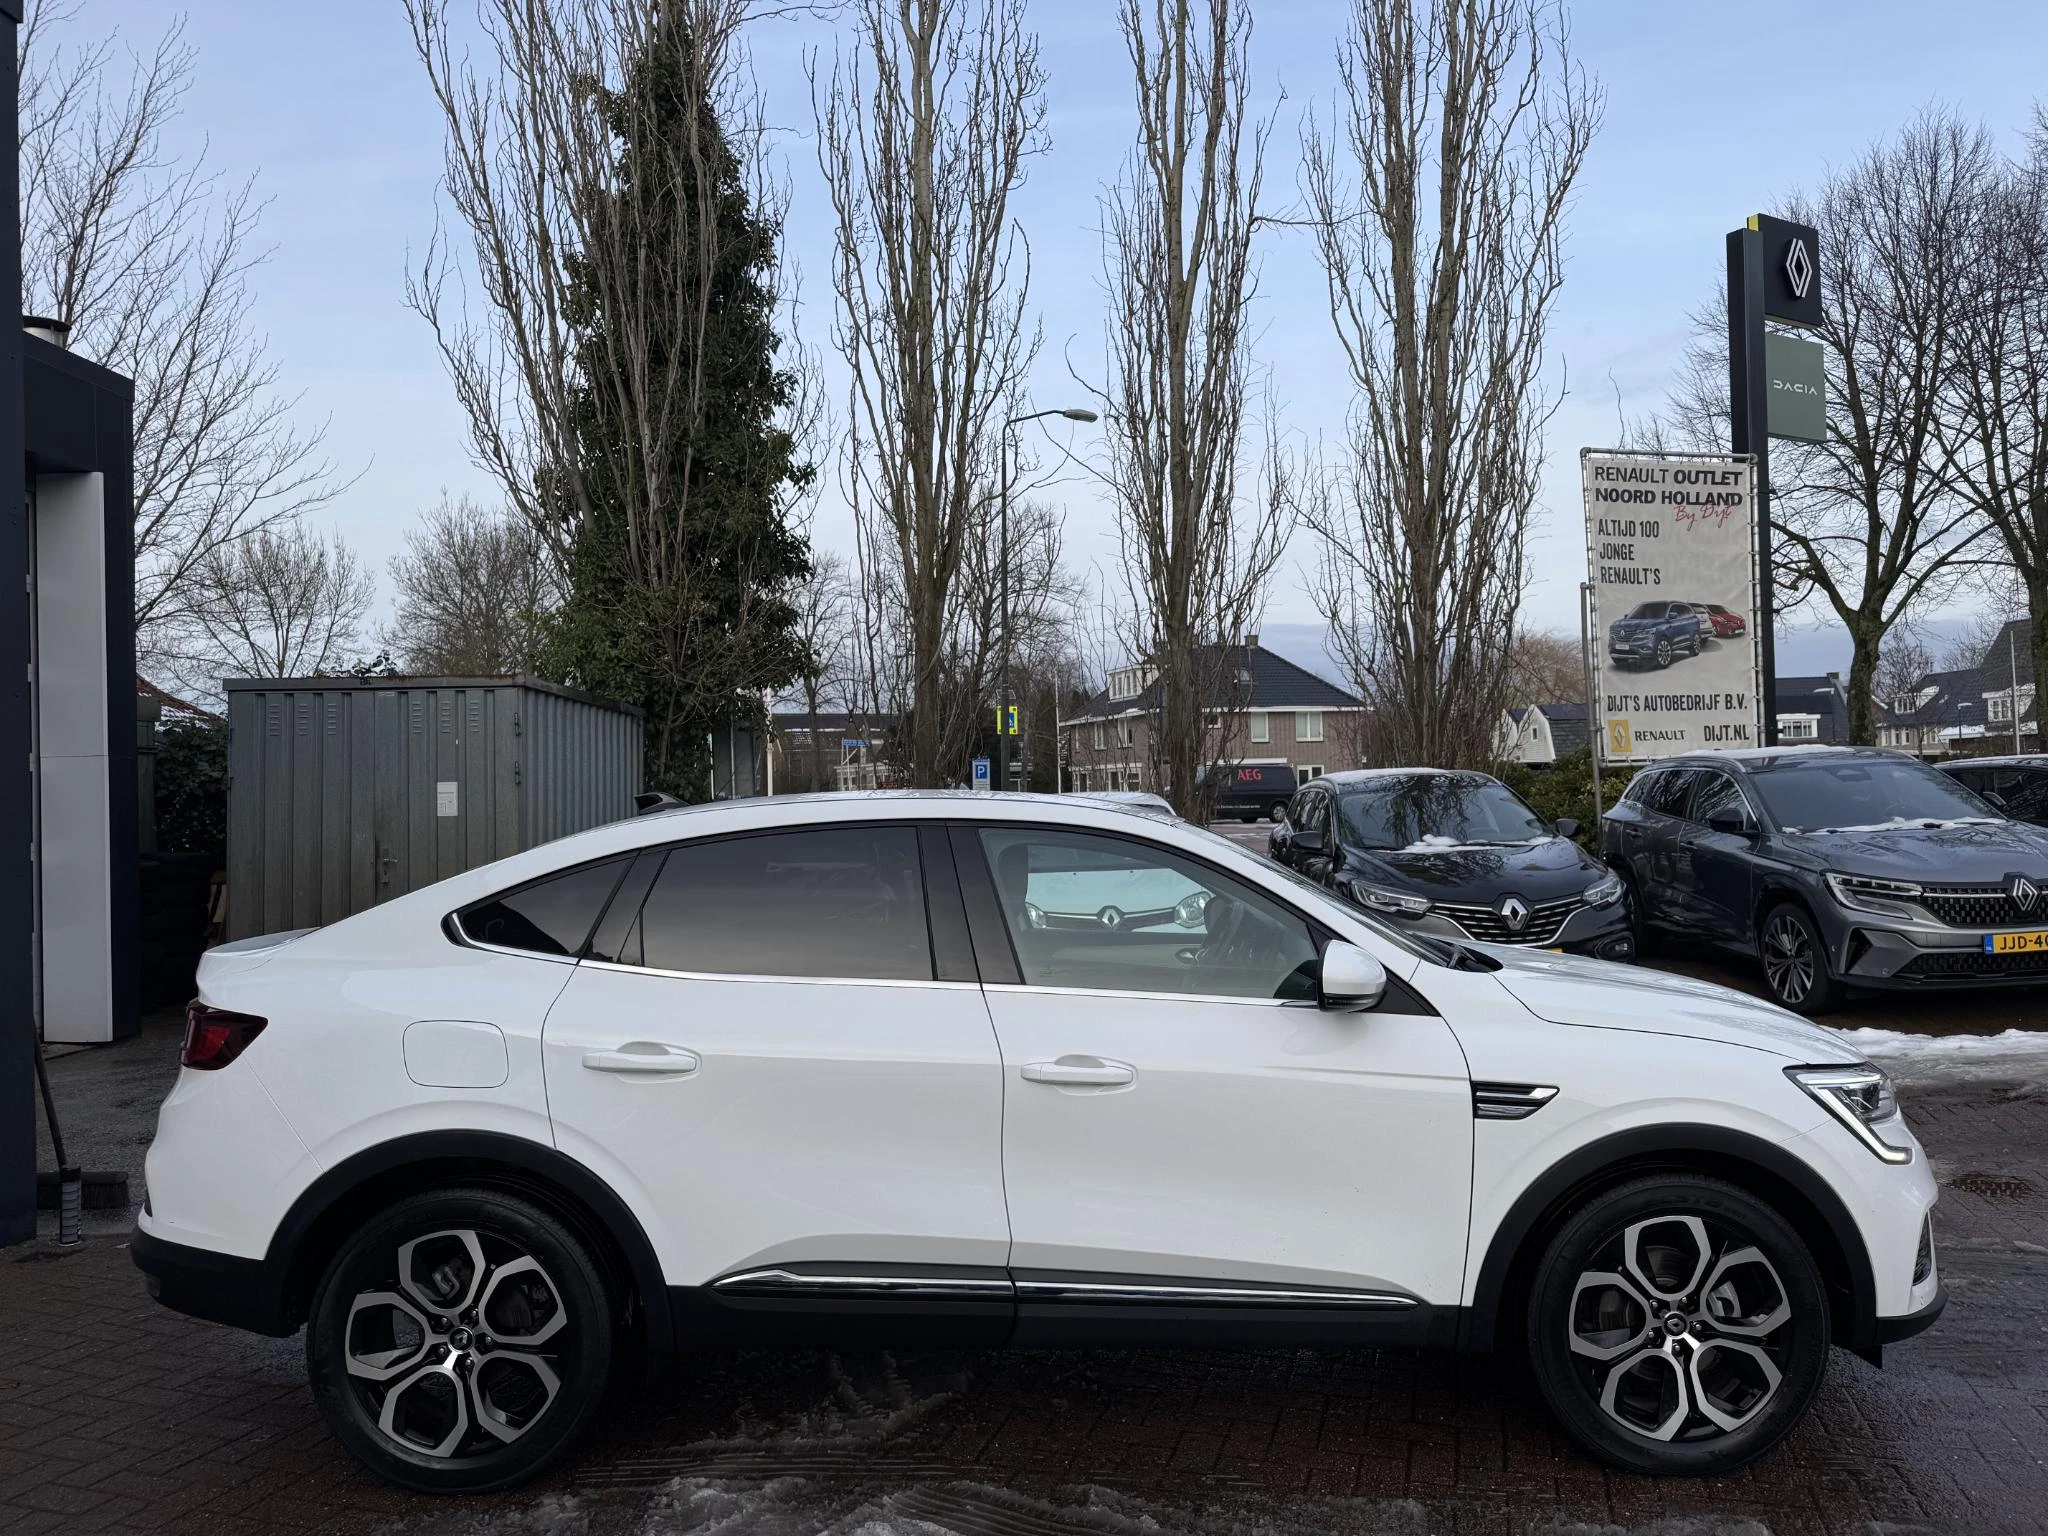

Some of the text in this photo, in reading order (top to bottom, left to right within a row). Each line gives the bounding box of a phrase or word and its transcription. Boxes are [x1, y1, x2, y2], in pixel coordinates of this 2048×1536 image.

[1773, 379, 1817, 395] DACIA
[1594, 466, 1743, 485] RENAULT OUTLET
[1595, 488, 1743, 506] NOORD HOLLAND
[1674, 505, 1697, 532] By
[1598, 519, 1660, 538] ALTIJD 100
[1600, 543, 1635, 561] JONGE
[1600, 566, 1661, 585] RENAULT'S
[1607, 693, 1748, 711] DIJT'S AUTOBEDRIJF B.V.
[1634, 724, 1750, 742] RENAULT DIJT.NL
[977, 765, 985, 778] P
[1237, 768, 1262, 780] AEG
